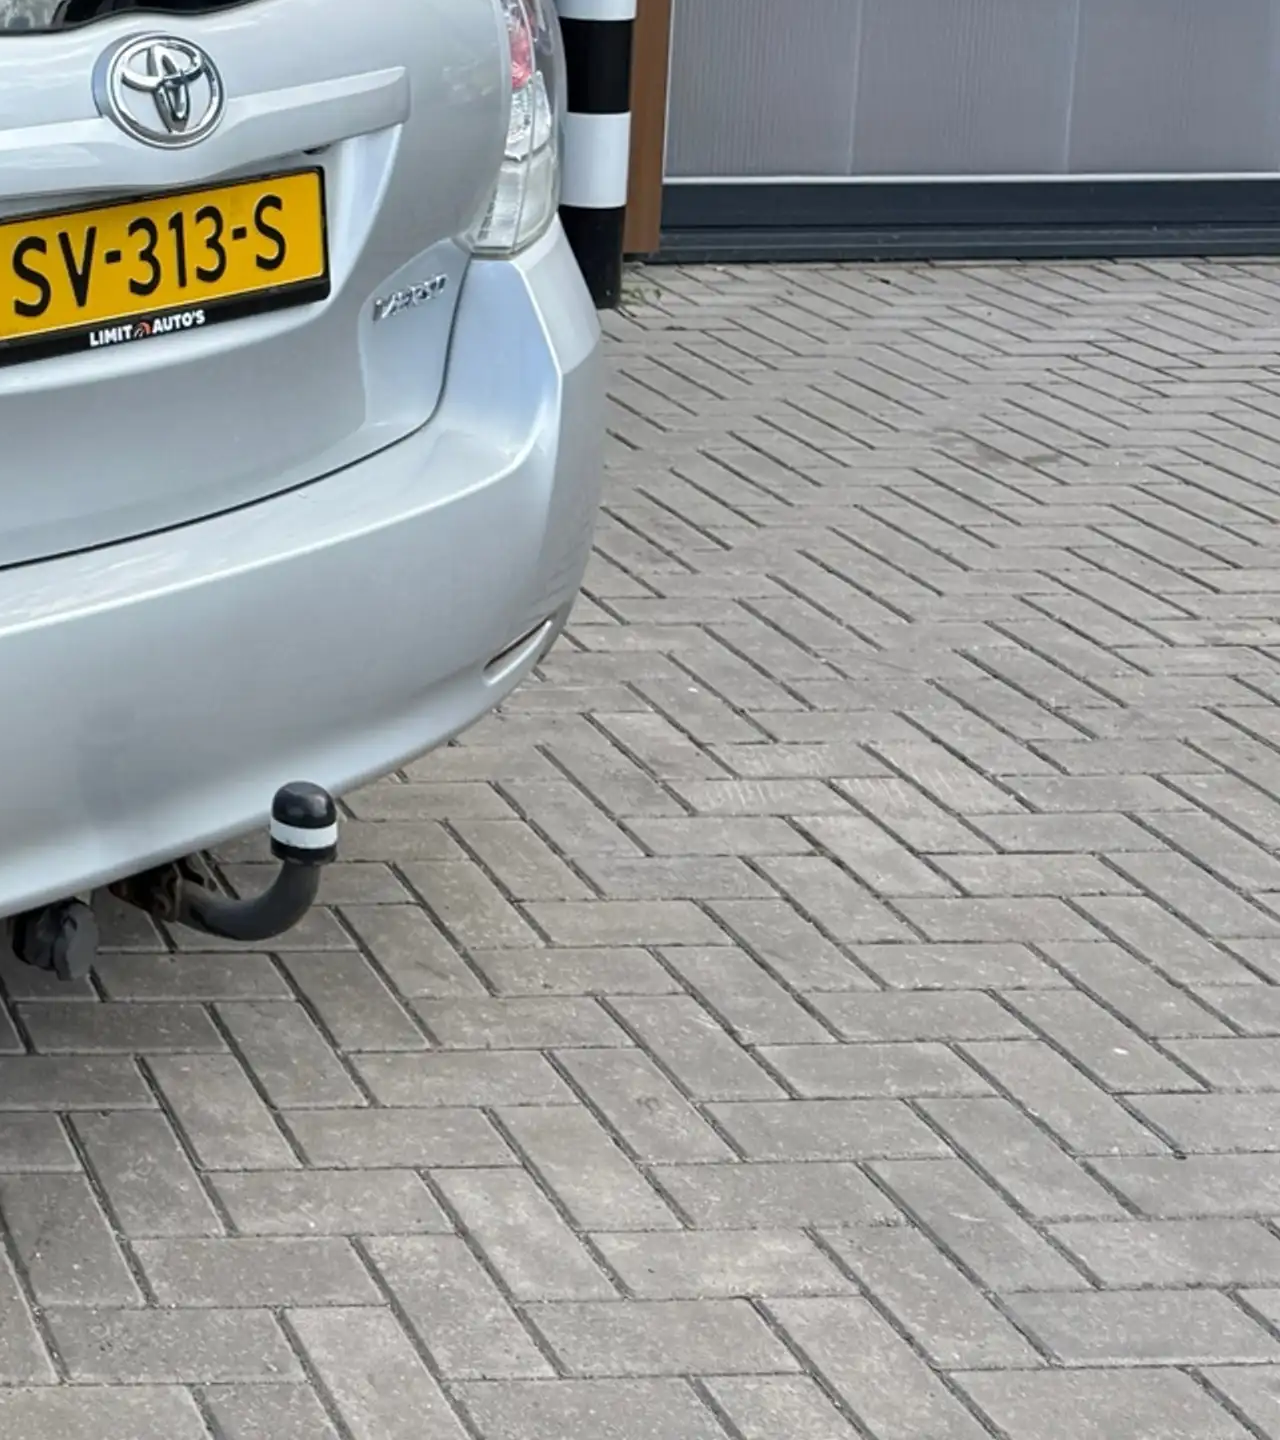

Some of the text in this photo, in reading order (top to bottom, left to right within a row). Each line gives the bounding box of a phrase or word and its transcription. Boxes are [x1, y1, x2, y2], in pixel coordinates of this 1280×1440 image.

[12, 194, 287, 318] SV-313-S
[89, 310, 206, 347] LIMIT AUTO'S
